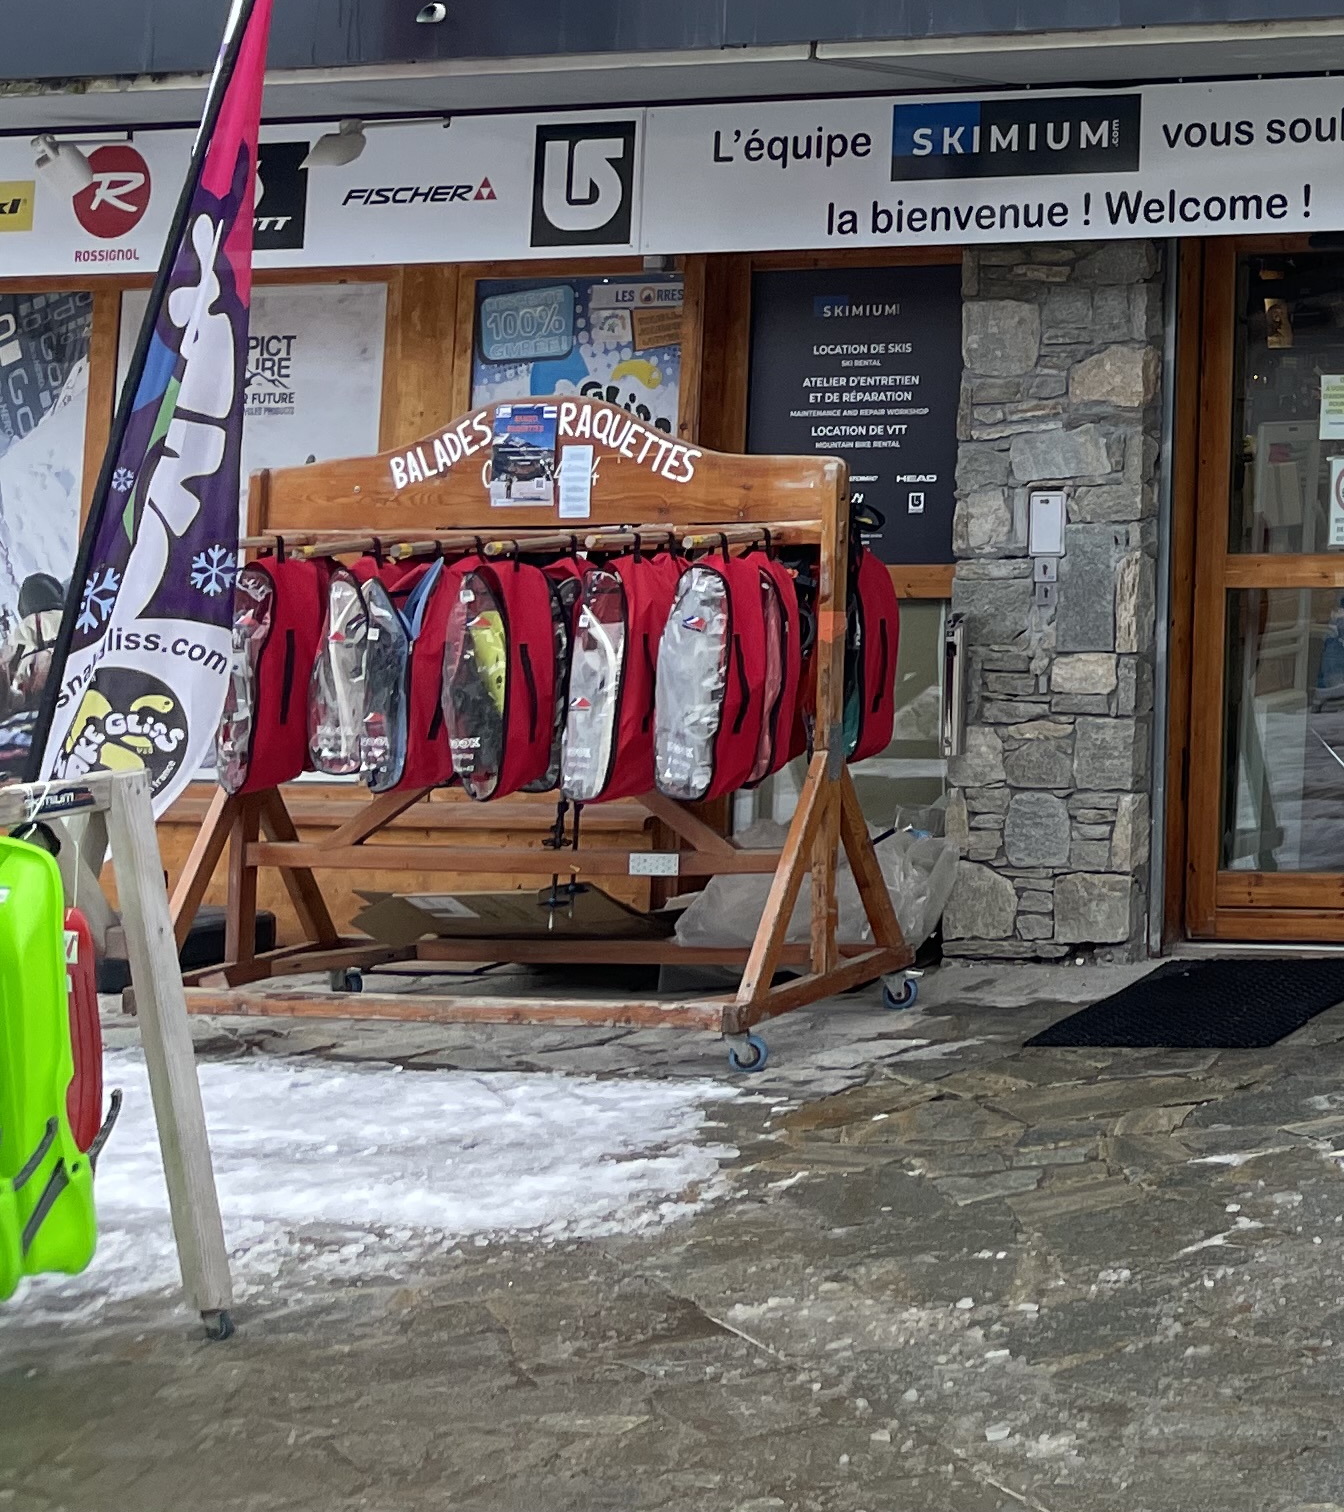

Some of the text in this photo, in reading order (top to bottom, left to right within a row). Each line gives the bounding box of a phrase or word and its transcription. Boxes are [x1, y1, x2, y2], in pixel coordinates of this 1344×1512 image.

[712, 126, 872, 168] L'équipe
[912, 119, 1110, 156] SKIMIUM
[1161, 117, 1255, 149] vous
[341, 184, 474, 206] FISCHER
[826, 203, 859, 236] la
[871, 193, 1069, 233] bienvenue
[1104, 187, 1288, 226] Welcome
[74, 247, 140, 263] ROSSIGNOL
[615, 285, 684, 306] LES ORRES
[823, 303, 897, 318] SKIMIUM
[486, 303, 566, 341] 100%
[813, 343, 913, 355] LOCATION DE SKIS
[854, 358, 882, 367] RENTAL
[802, 375, 920, 388] ATELIER D'ENTRETIEN
[251, 392, 295, 405] FUTURE
[809, 389, 913, 403] ET DE RÉPARATION
[811, 424, 908, 437] LOCATION DE VTT
[389, 410, 493, 489] BALADES
[558, 401, 703, 484] RAQUETTES
[896, 474, 938, 483] HEAD
